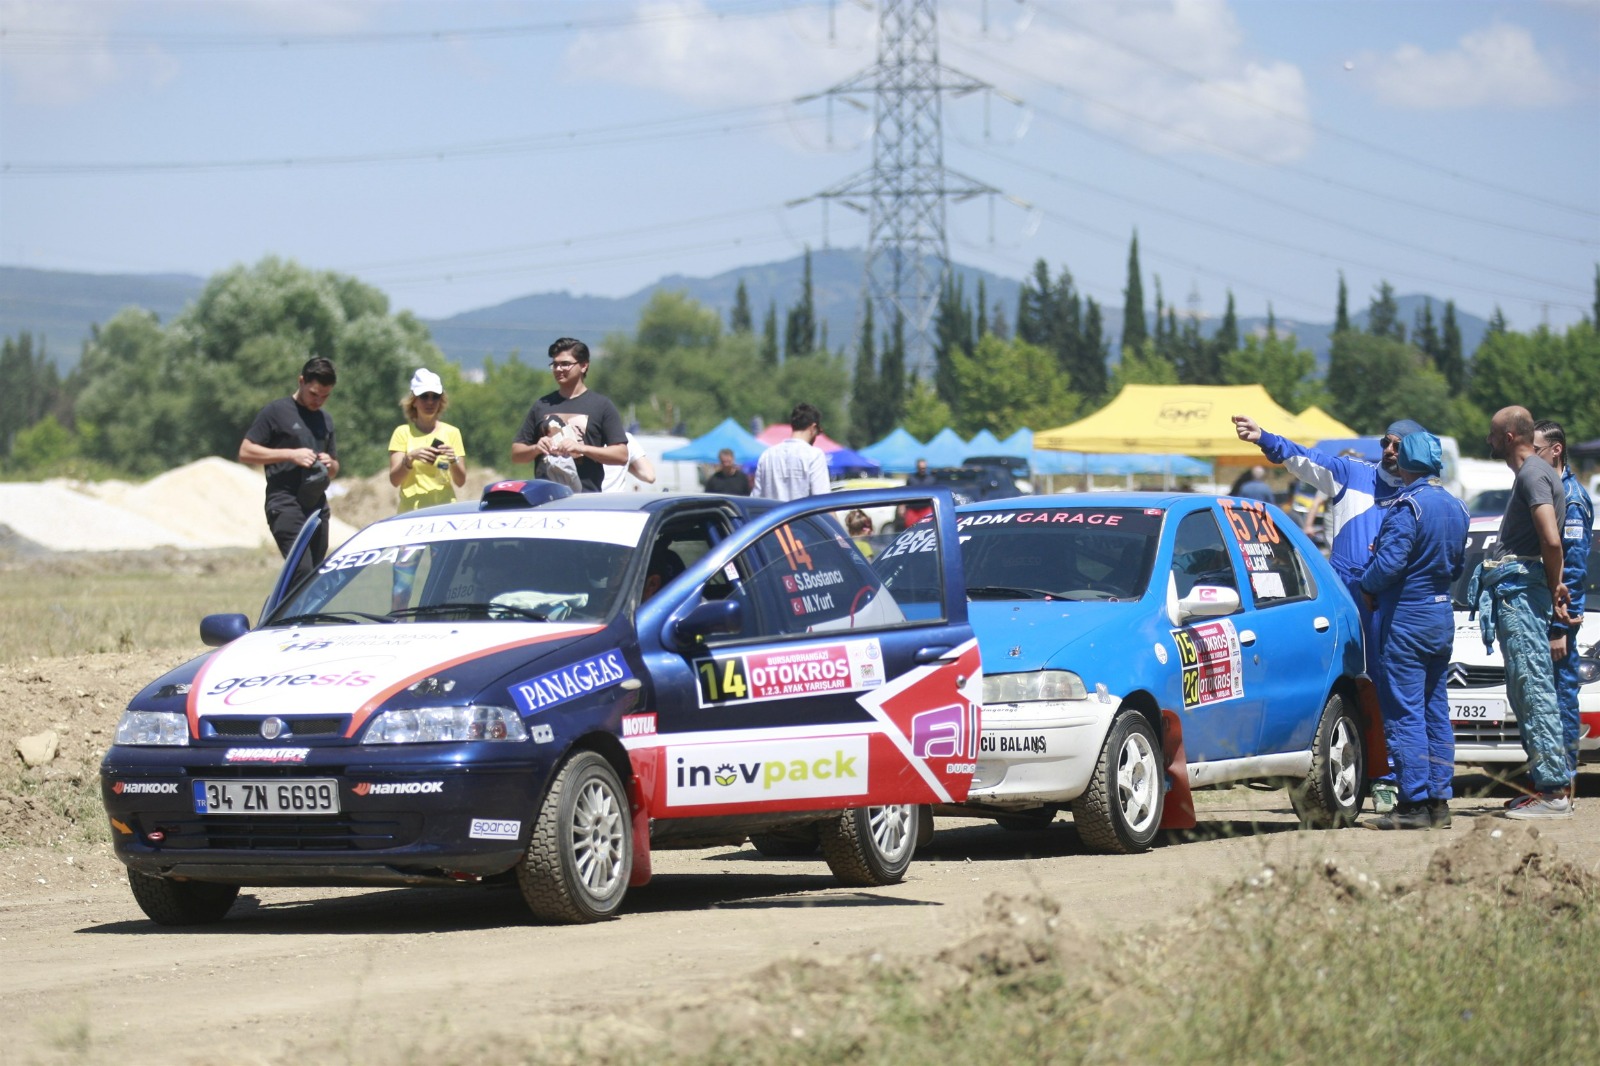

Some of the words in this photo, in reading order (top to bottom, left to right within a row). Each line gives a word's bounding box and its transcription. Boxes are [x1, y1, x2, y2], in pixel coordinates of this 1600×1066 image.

[404, 516, 571, 537] PANAGEAS
[1016, 512, 1123, 526] GARAGE
[1216, 499, 1251, 541] 15
[318, 545, 427, 575] SEDAT
[774, 523, 814, 571] 14
[801, 592, 835, 614] M.Yurt
[1175, 632, 1197, 664] 15
[1195, 634, 1228, 654] OTOKROS
[207, 670, 377, 696] genesis
[518, 654, 624, 711] PANAGEAS
[700, 660, 746, 700] 14
[752, 659, 849, 686] OTOKROS
[1200, 673, 1231, 693] OTOKROS
[760, 685, 782, 696] 1.2.3.
[782, 683, 805, 694] AYAK
[1184, 671, 1198, 704] 20
[1455, 705, 1487, 718] 7832
[622, 715, 656, 735] MOTUL
[676, 750, 858, 790] inovpack
[197, 799, 208, 807] TR
[207, 784, 234, 810] 34
[242, 785, 269, 810] ZN
[277, 785, 332, 810] 6699
[473, 820, 519, 834] sparco
